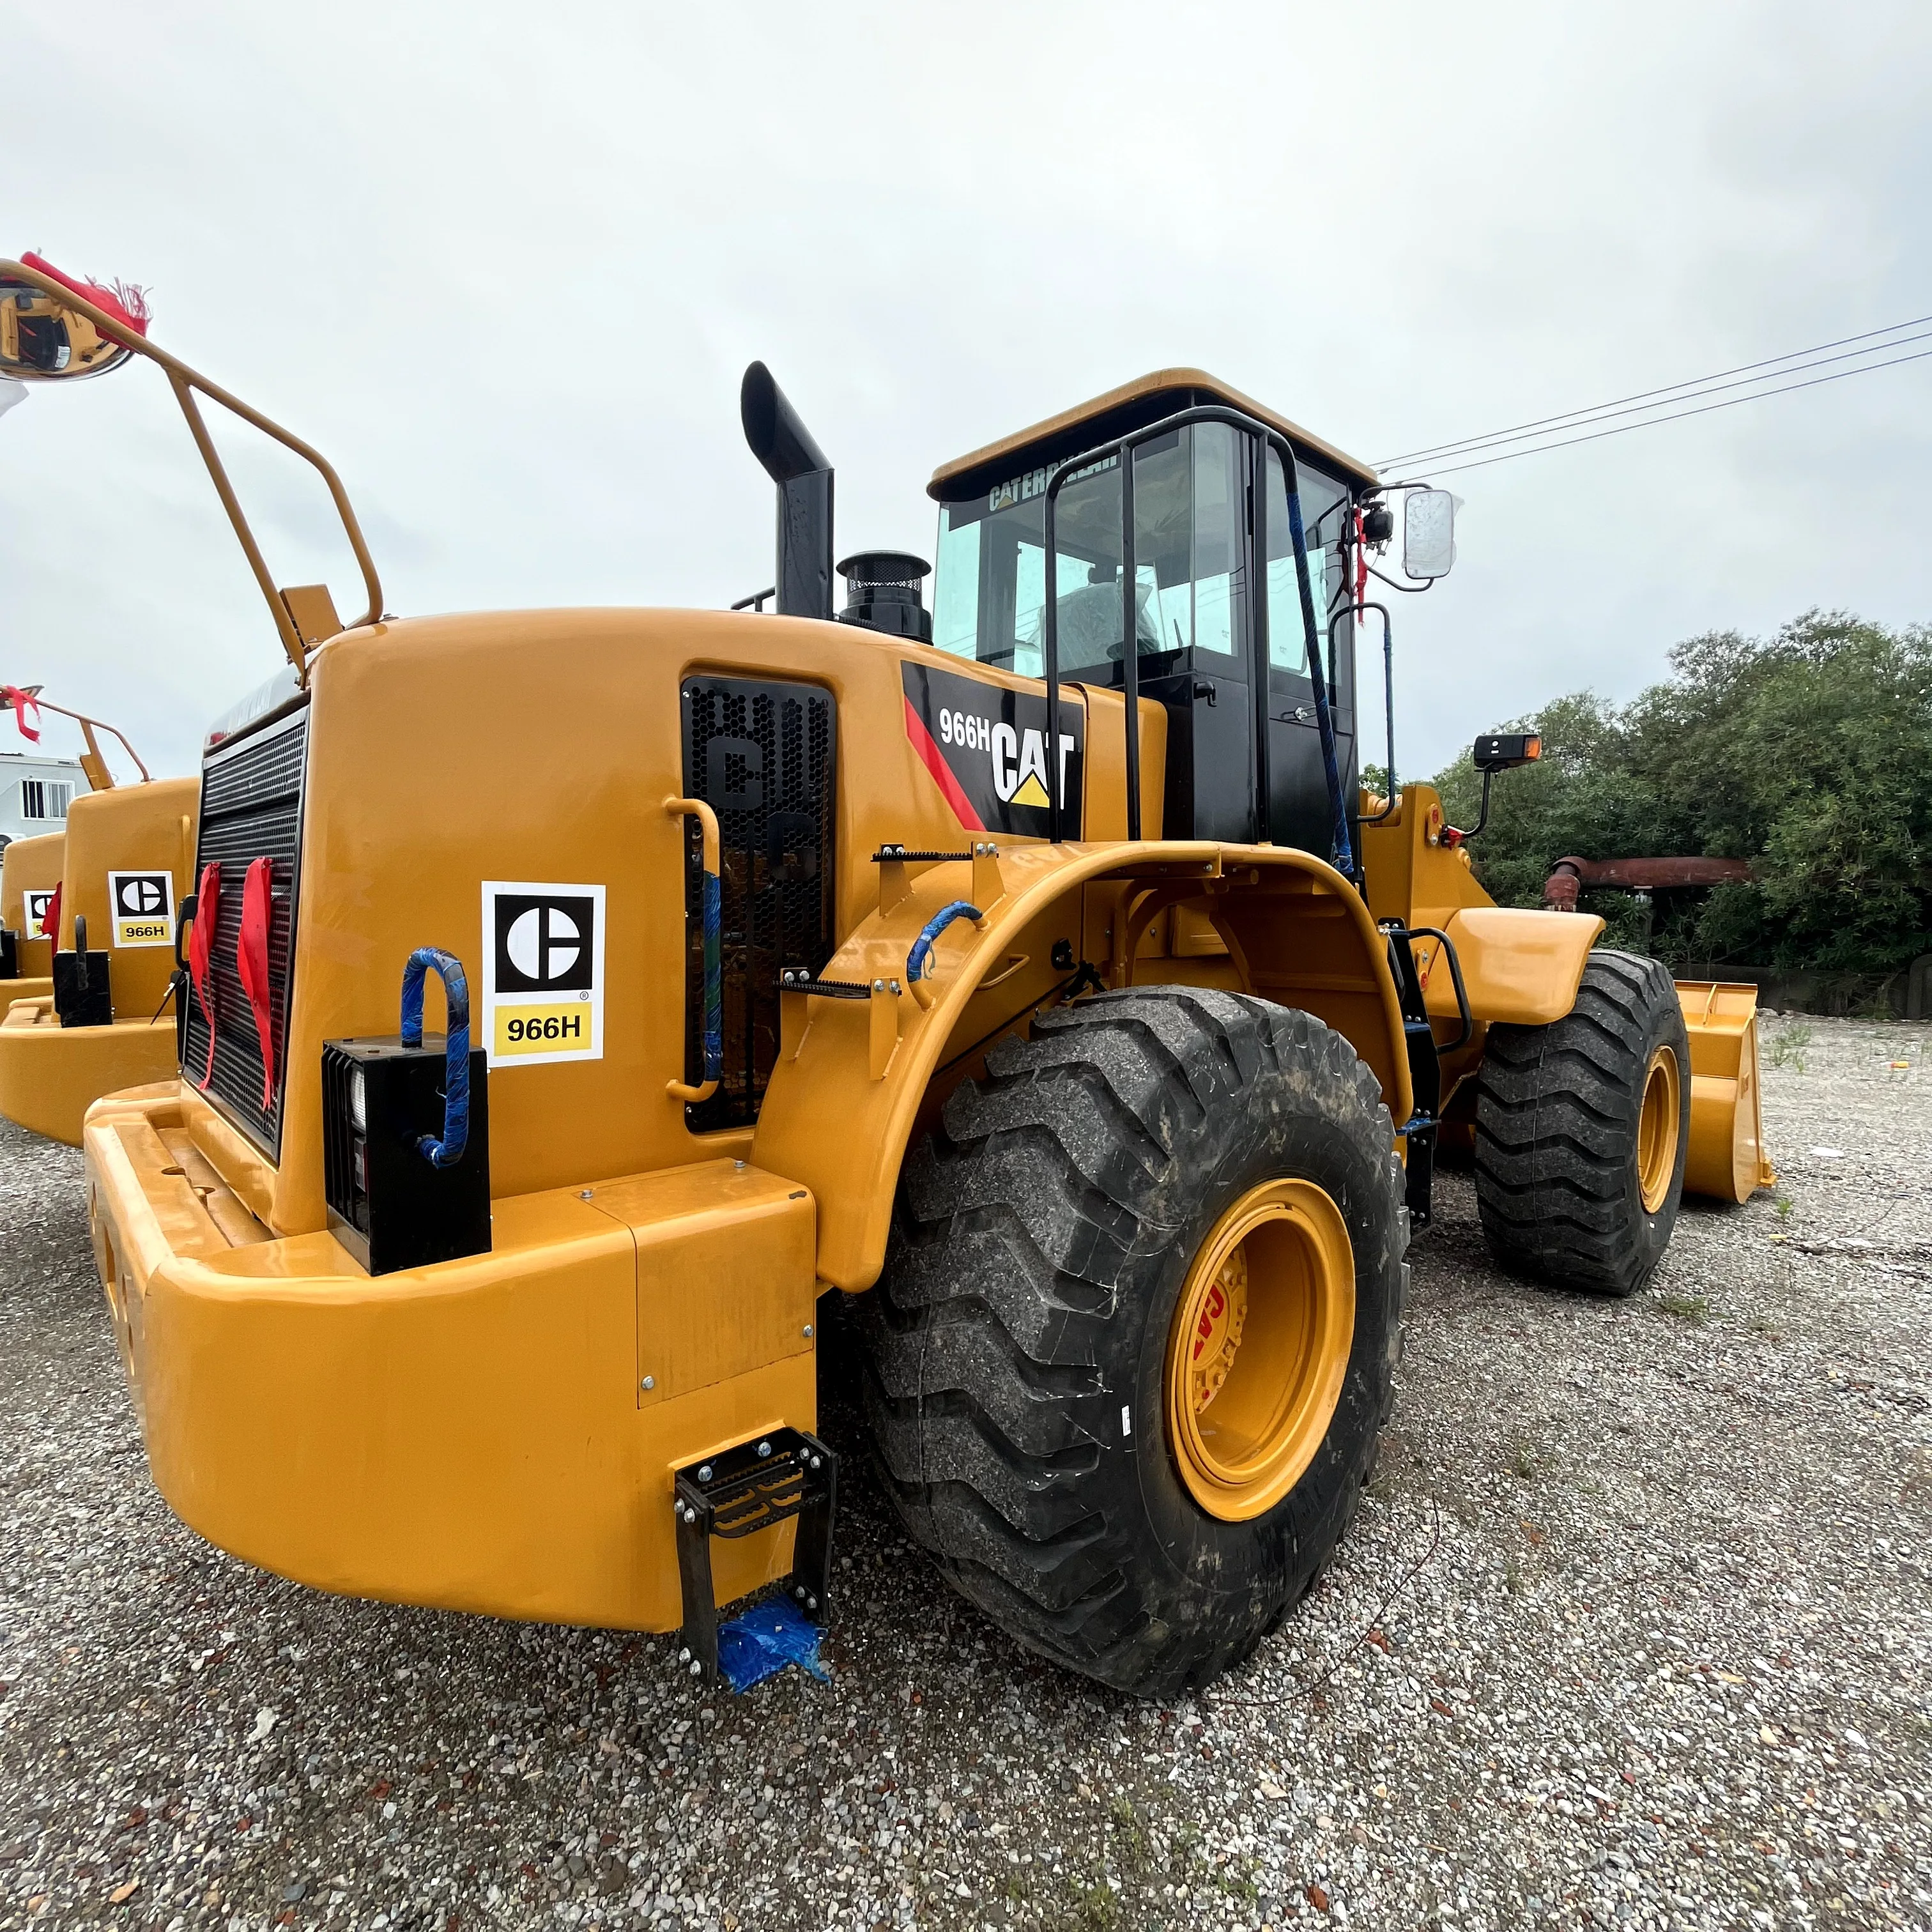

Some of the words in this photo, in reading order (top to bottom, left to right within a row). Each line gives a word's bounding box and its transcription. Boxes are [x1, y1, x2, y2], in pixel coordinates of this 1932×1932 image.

[940, 708, 990, 752] 966H
[992, 723, 1075, 810] CAT
[126, 926, 164, 937] 966H
[508, 1015, 580, 1041] 966H
